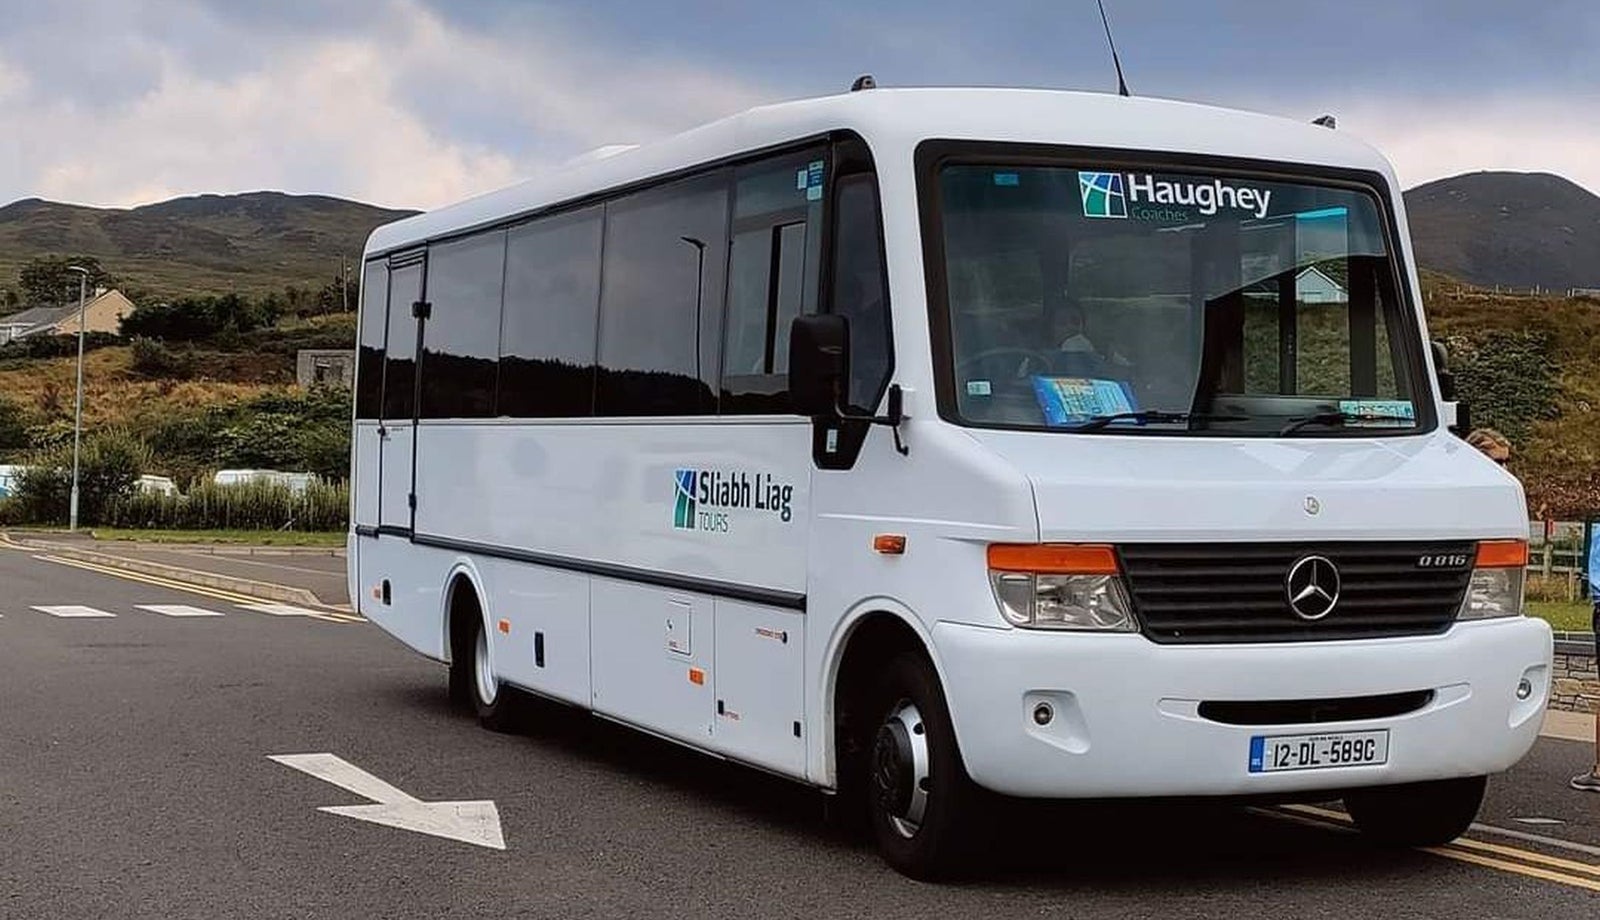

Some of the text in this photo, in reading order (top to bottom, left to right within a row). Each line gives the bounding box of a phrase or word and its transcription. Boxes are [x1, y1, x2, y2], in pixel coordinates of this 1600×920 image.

[1127, 173, 1271, 219] Haughey
[1131, 206, 1188, 222] Coaches
[699, 470, 794, 522] Sliabh Liag
[698, 511, 729, 533] TOURS
